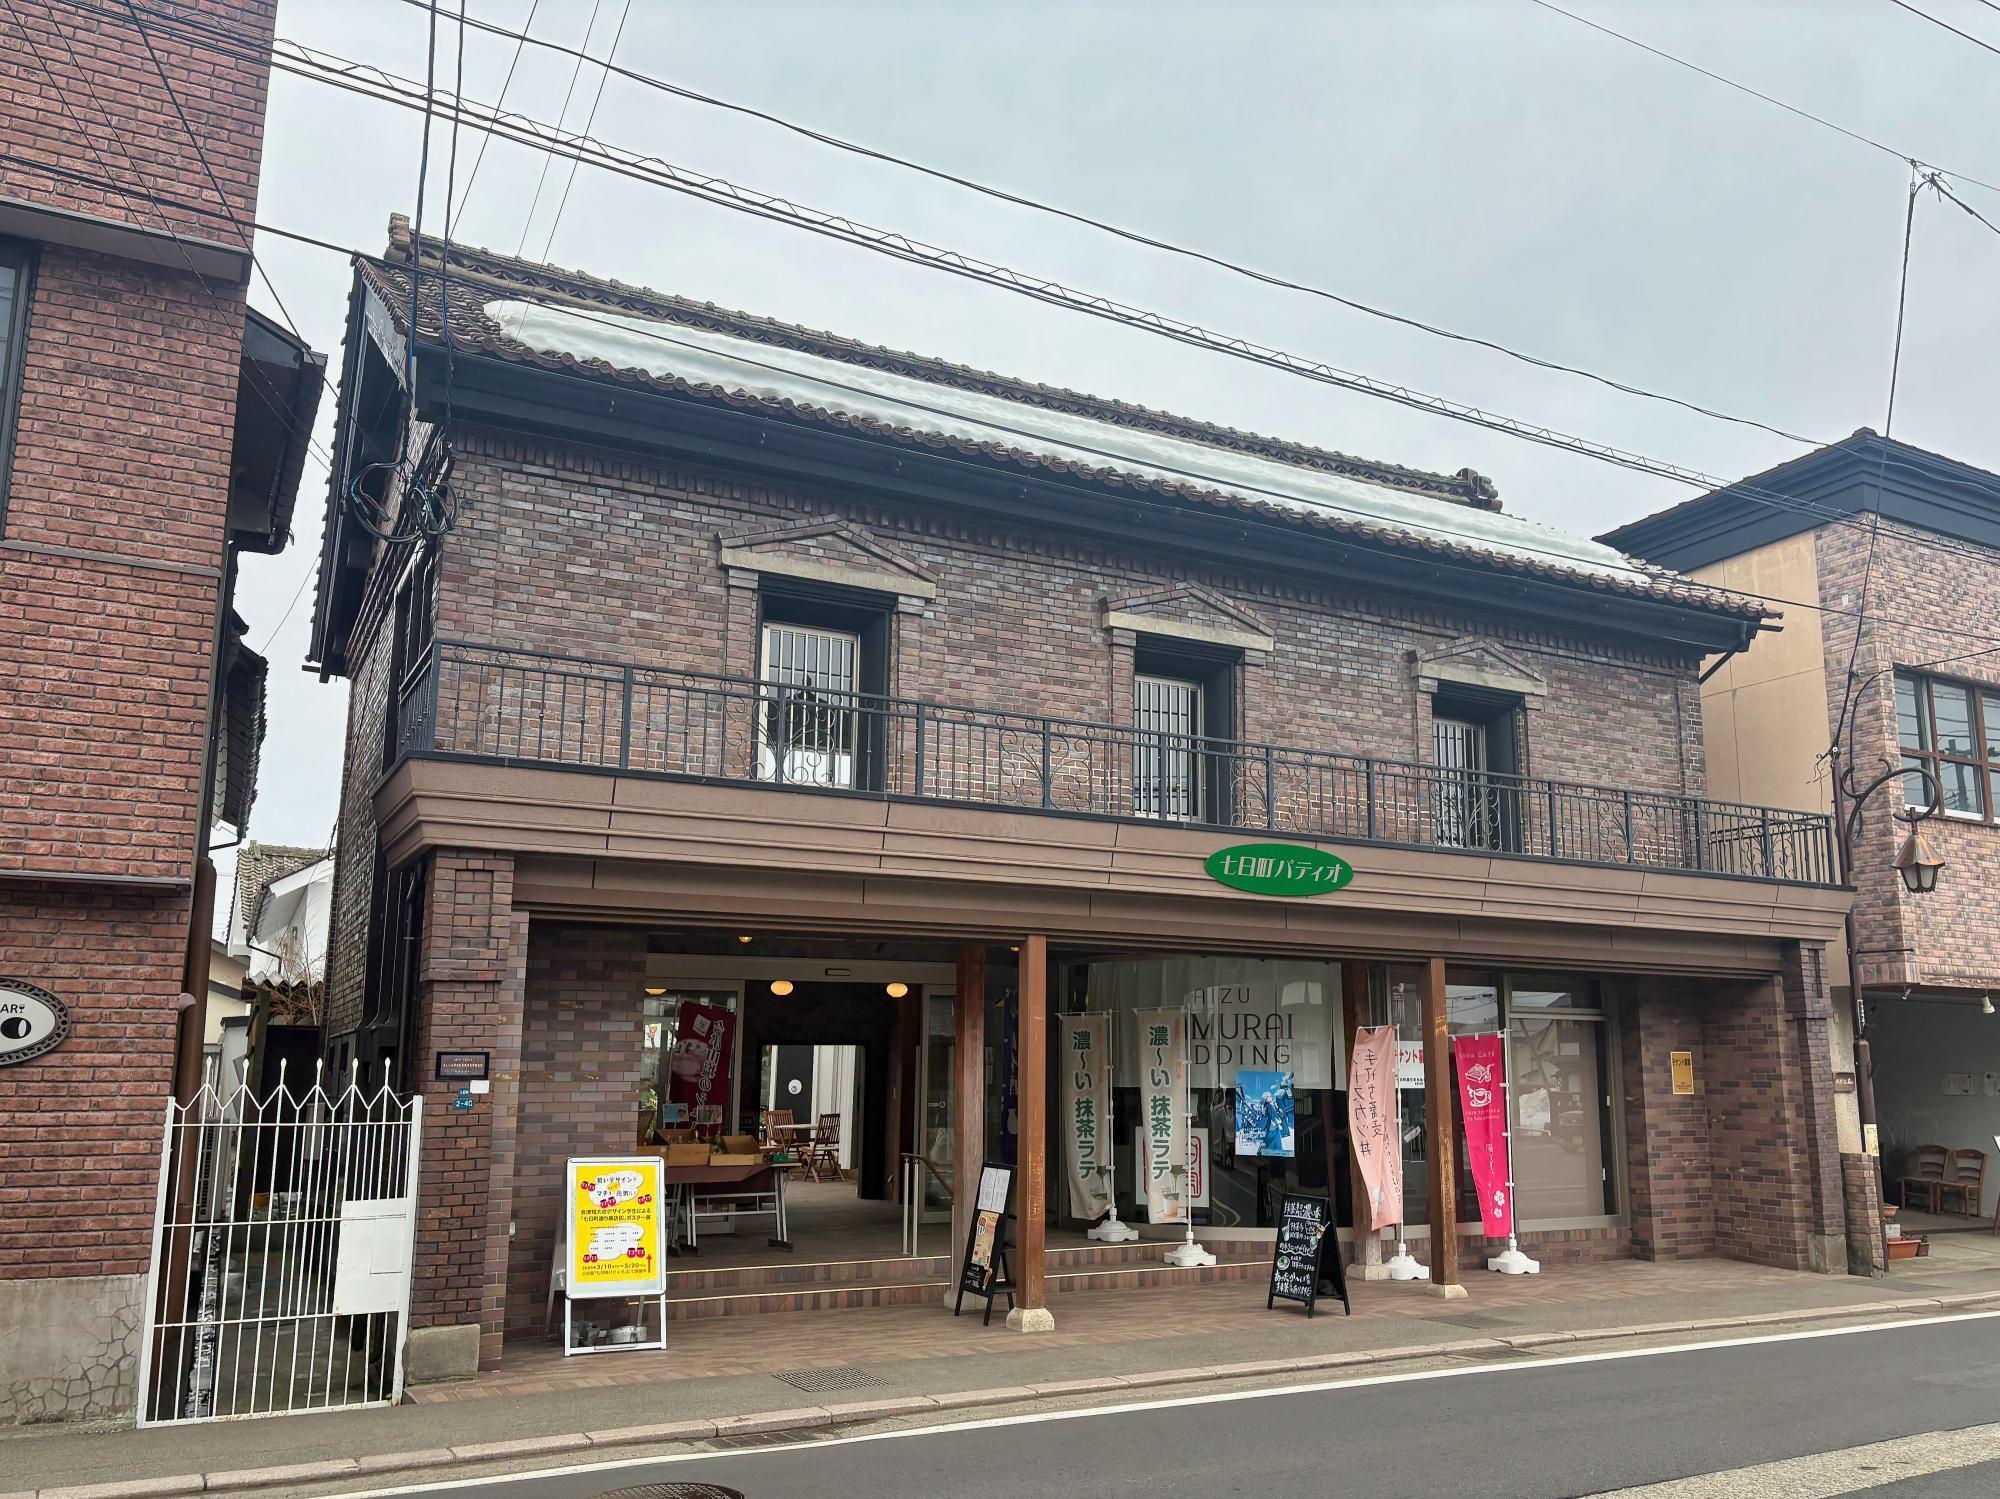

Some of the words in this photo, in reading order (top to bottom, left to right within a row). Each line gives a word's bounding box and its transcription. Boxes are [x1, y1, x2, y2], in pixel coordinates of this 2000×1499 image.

[1220, 855, 1343, 883] 七日町パティオ
[1194, 987, 1250, 1004] AIZU
[1184, 1013, 1295, 1040] MURAI
[455, 1099, 473, 1107] 2-40
[1074, 1097, 1096, 1180] 抹茶ラテ
[1150, 1095, 1172, 1180] 抹茶ラテ
